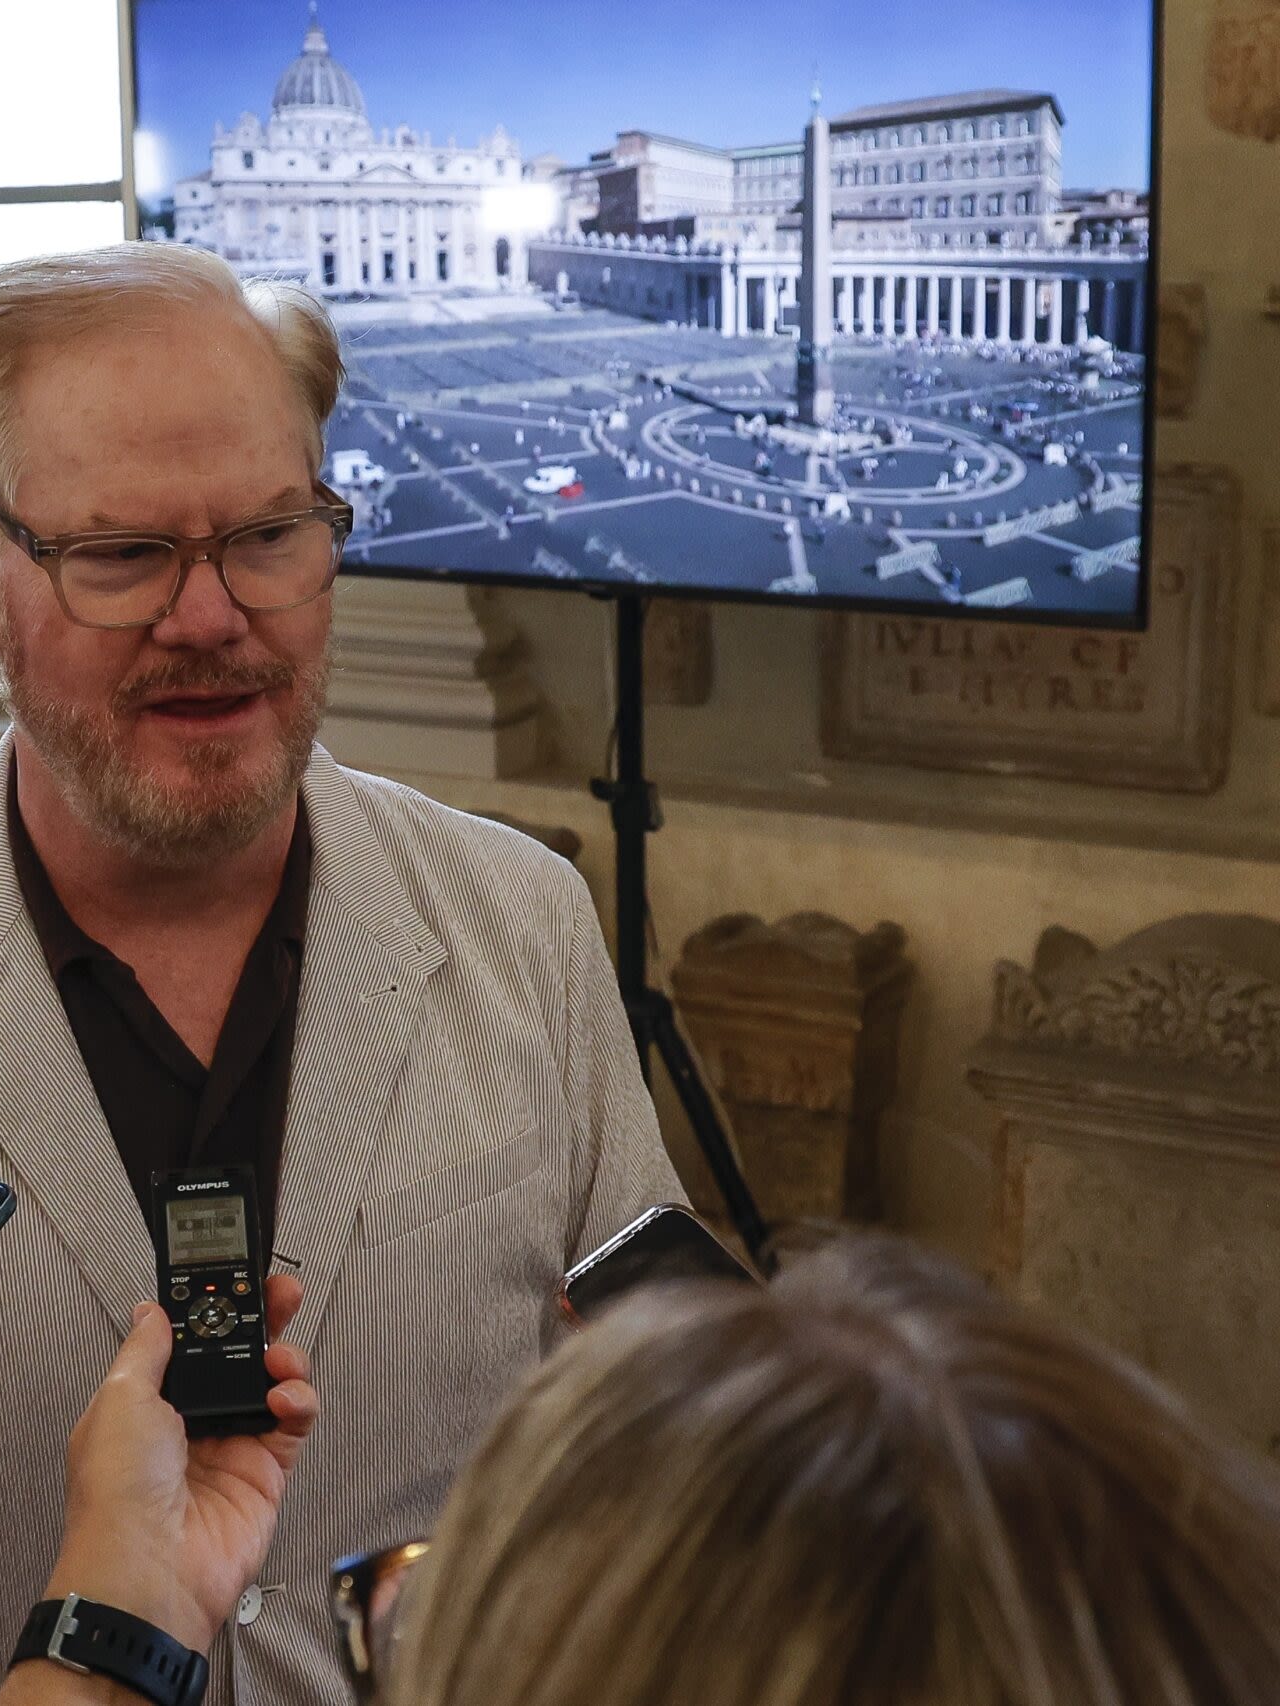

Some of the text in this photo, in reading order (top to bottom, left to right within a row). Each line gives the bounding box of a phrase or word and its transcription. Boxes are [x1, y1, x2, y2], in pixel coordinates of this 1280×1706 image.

[177, 1181, 230, 1192] OLYMPUS
[234, 1271, 248, 1279] REC
[171, 1276, 190, 1284] STOP
